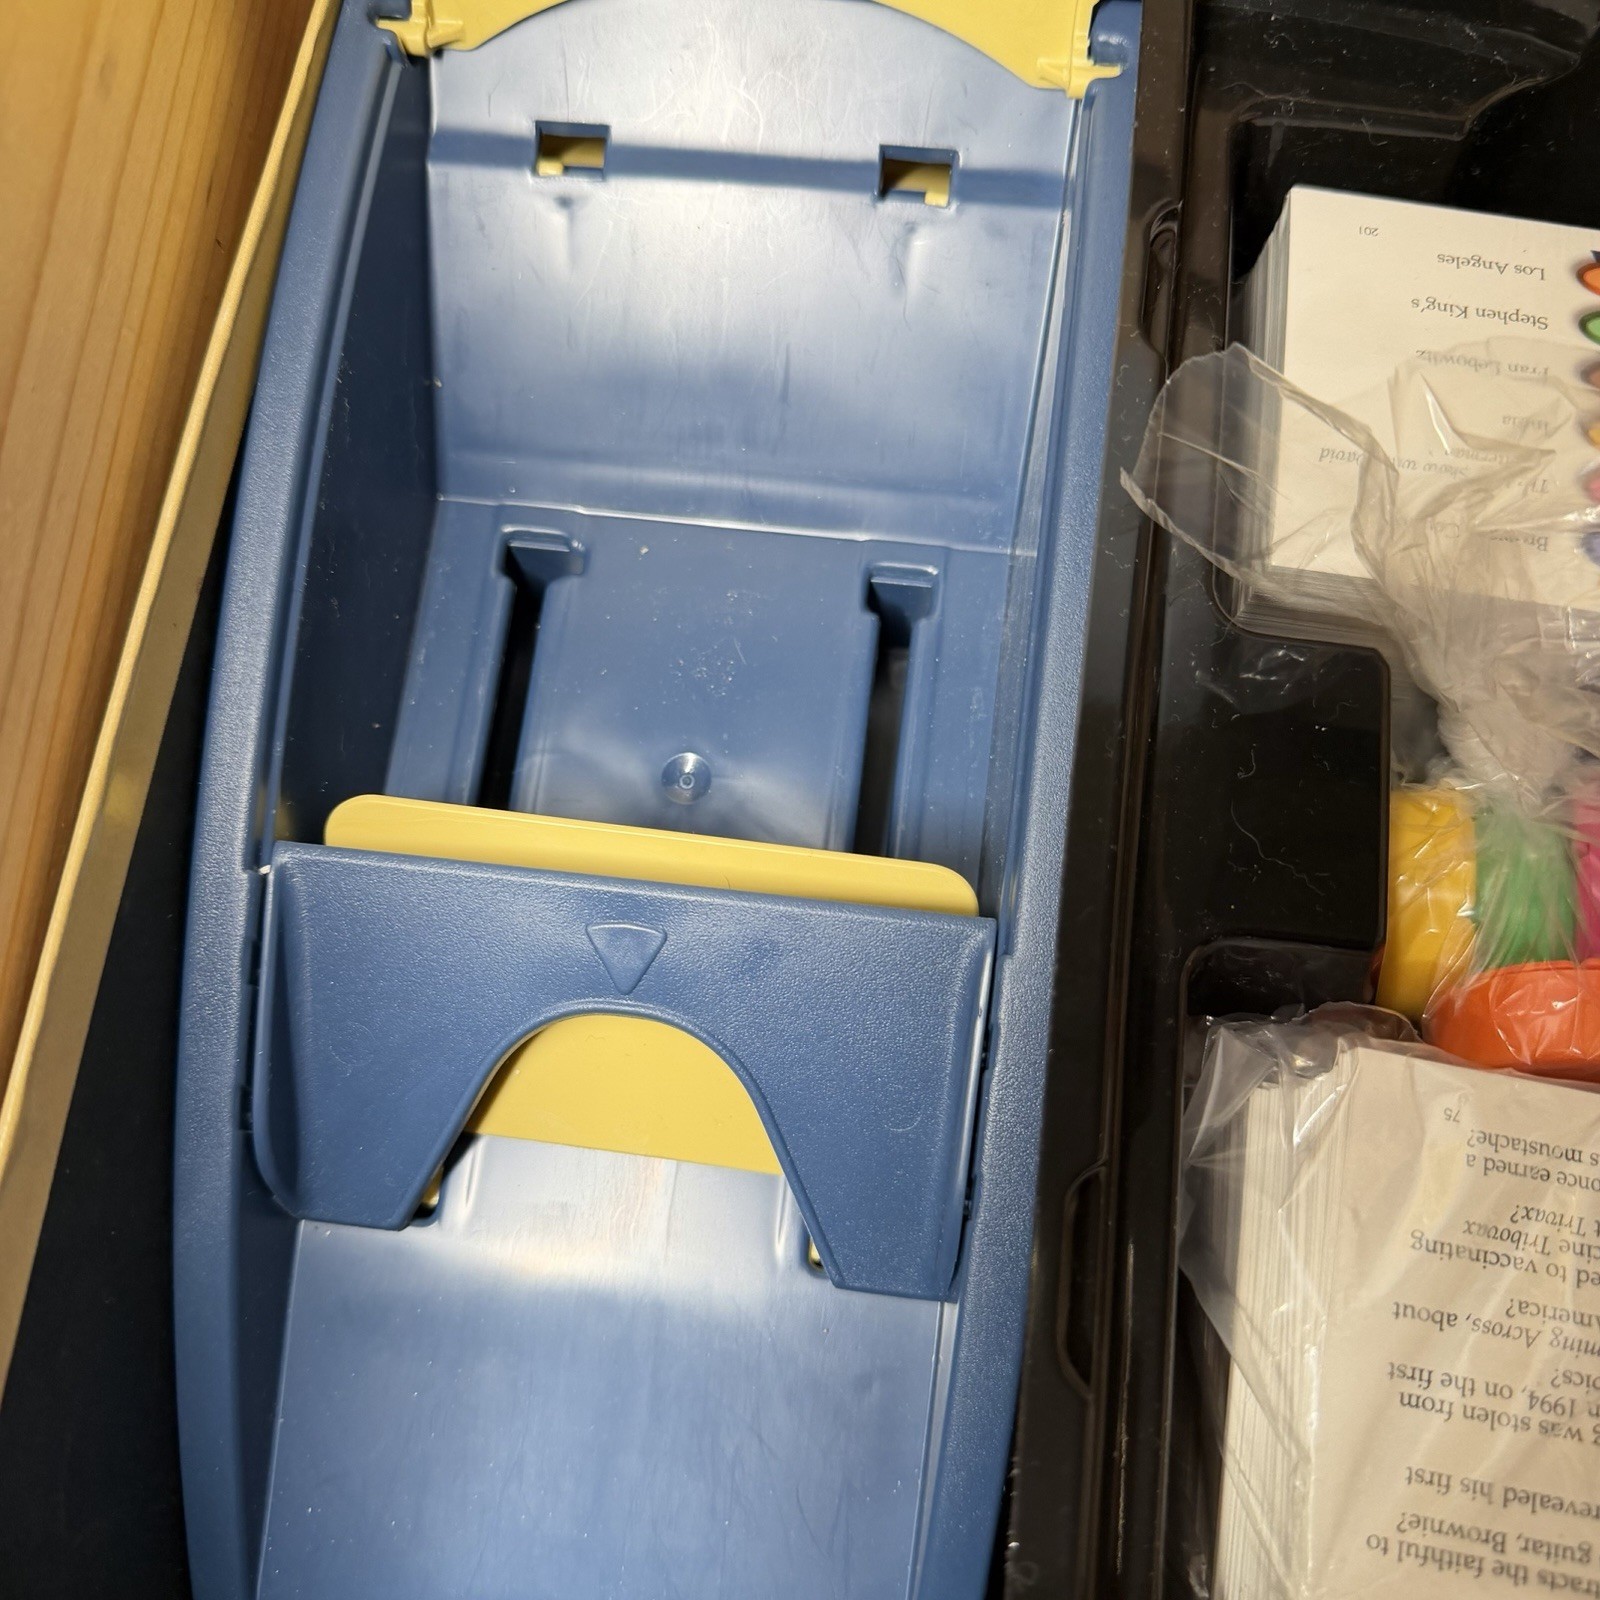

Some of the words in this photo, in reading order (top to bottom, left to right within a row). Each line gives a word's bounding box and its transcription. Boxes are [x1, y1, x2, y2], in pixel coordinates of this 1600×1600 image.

[1358, 225, 1379, 238] 201
[1436, 254, 1509, 275] Angeles
[1513, 264, 1546, 281] Los
[1410, 296, 1468, 320] King's
[1475, 308, 1549, 331] Stephen
[1318, 447, 1363, 466] avid
[1442, 1107, 1461, 1124] 75
[1466, 1129, 1583, 1164] moustache?
[1465, 1153, 1477, 1168] a
[1483, 1156, 1550, 1182] earned
[1556, 1170, 1600, 1193] once
[1510, 1204, 1586, 1237] Trivax?
[1409, 1229, 1538, 1274] vaccinating
[1462, 1220, 1550, 1256] Tribovax
[1545, 1262, 1567, 1284] to
[1392, 1301, 1458, 1332] about
[1464, 1313, 1542, 1349] Across,
[1387, 1362, 1434, 1390] first
[1440, 1372, 1476, 1399] the
[1484, 1381, 1513, 1400] on
[1521, 1385, 1577, 1420] 1994,
[1398, 1391, 1454, 1422] from
[1462, 1404, 1532, 1432] stolen
[1538, 1419, 1584, 1444] was
[1404, 1466, 1451, 1496] first
[1460, 1477, 1494, 1505] his
[1503, 1486, 1600, 1521] revealed
[1366, 1534, 1389, 1557] to
[1396, 1512, 1507, 1554] Brownie?
[1397, 1540, 1484, 1579] faithful
[1516, 1533, 1592, 1567] guitar,
[1492, 1560, 1529, 1587] the
